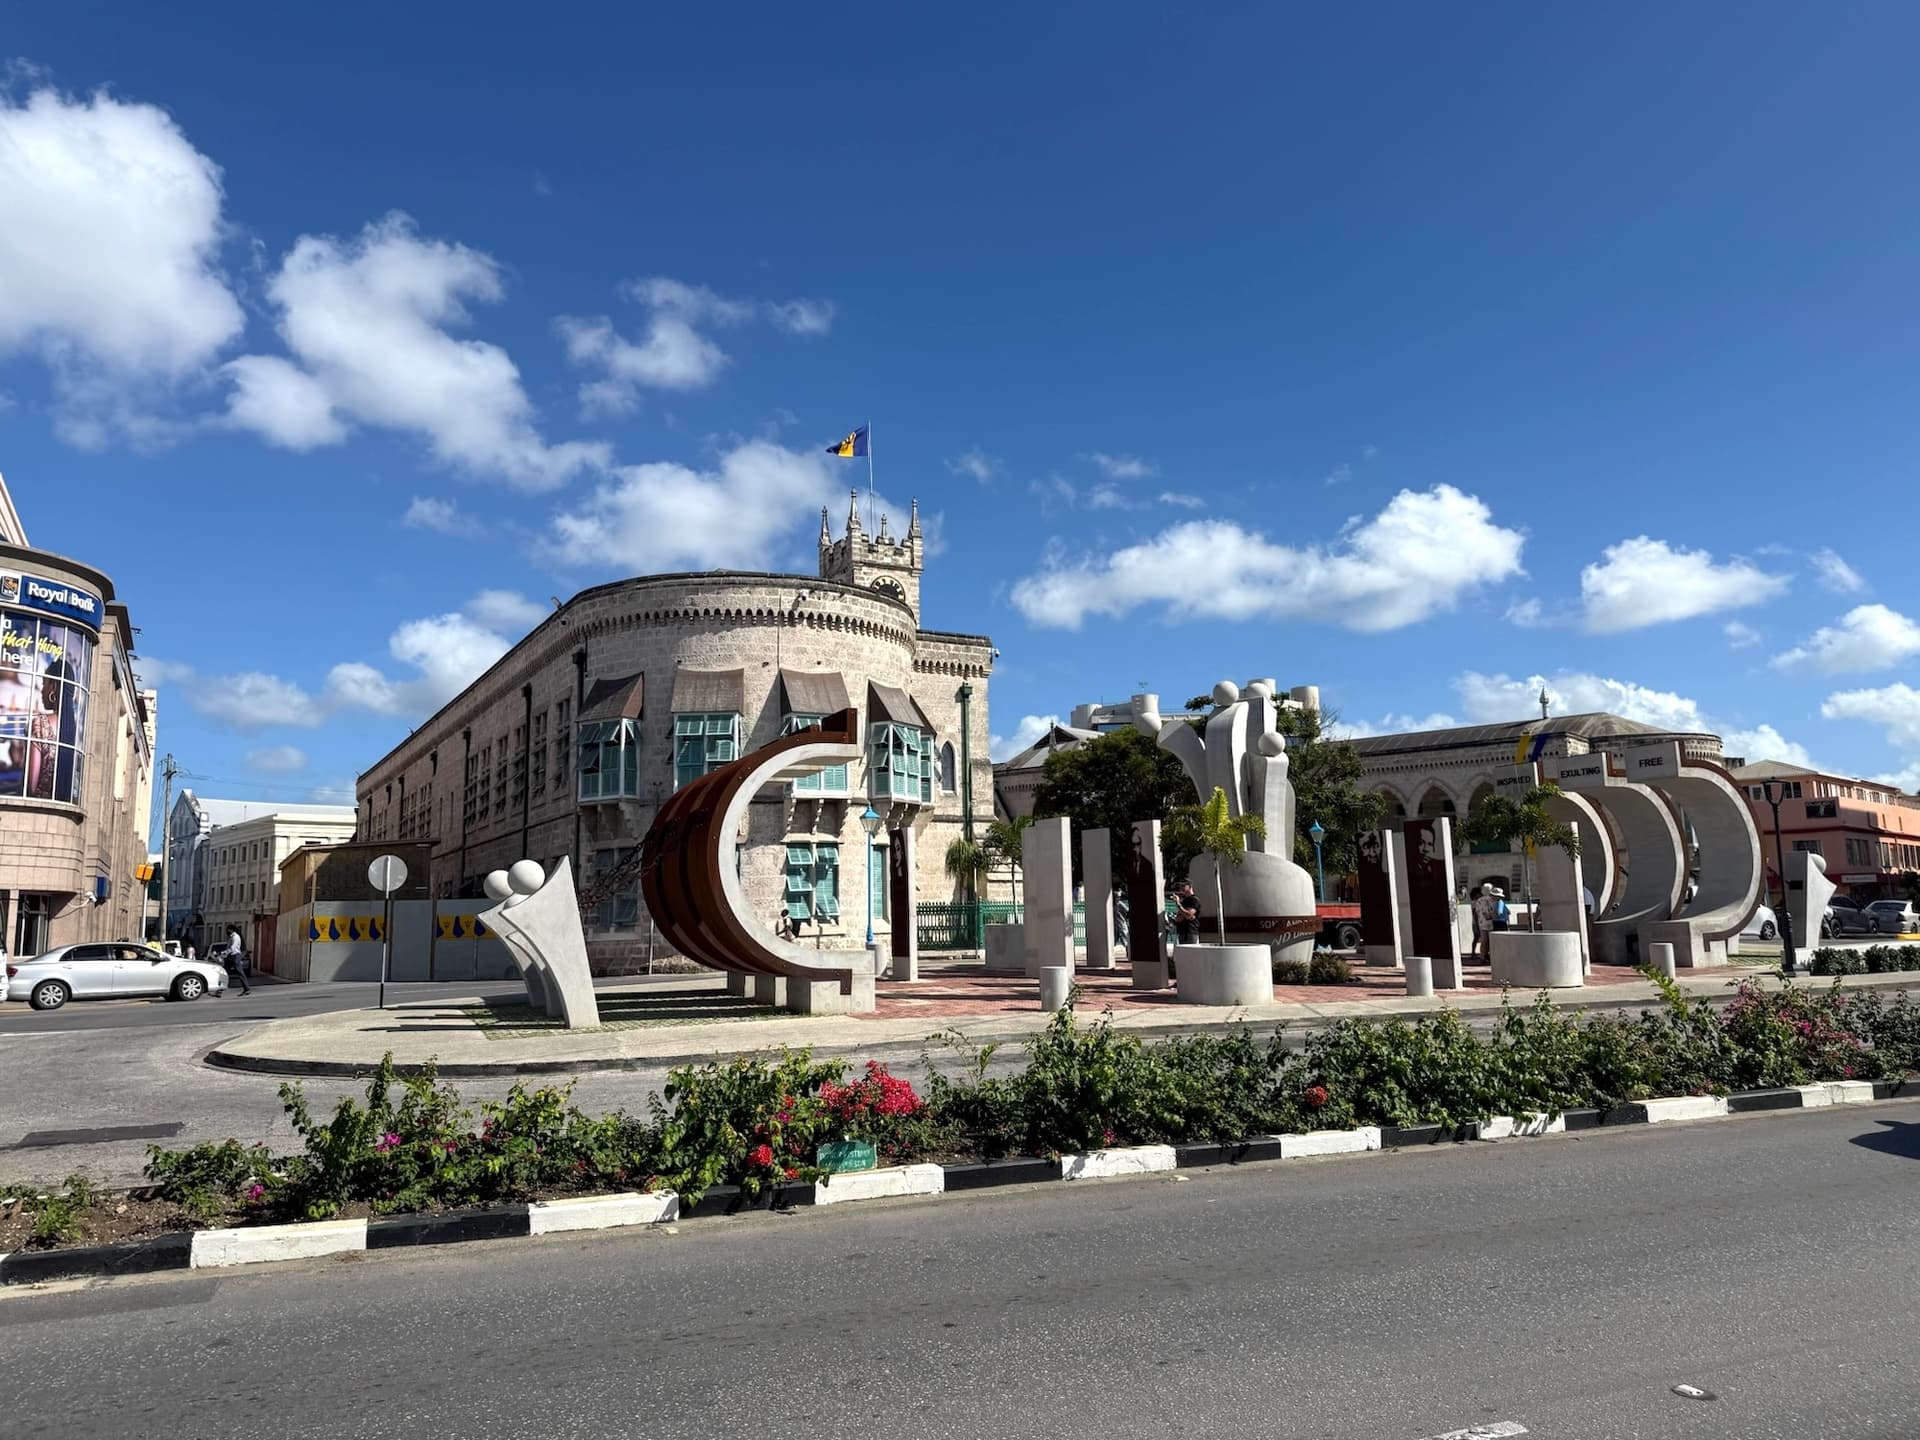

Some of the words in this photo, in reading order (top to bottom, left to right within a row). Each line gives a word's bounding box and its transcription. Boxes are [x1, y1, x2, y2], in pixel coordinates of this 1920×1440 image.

[28, 582, 68, 604] Royal
[70, 592, 95, 613] Bank
[1, 631, 34, 649] that
[37, 637, 64, 662] thing
[2, 648, 33, 666] here
[1639, 757, 1664, 768] FREE
[1561, 766, 1601, 778] EXULTING
[1497, 775, 1531, 787] INSPIRED
